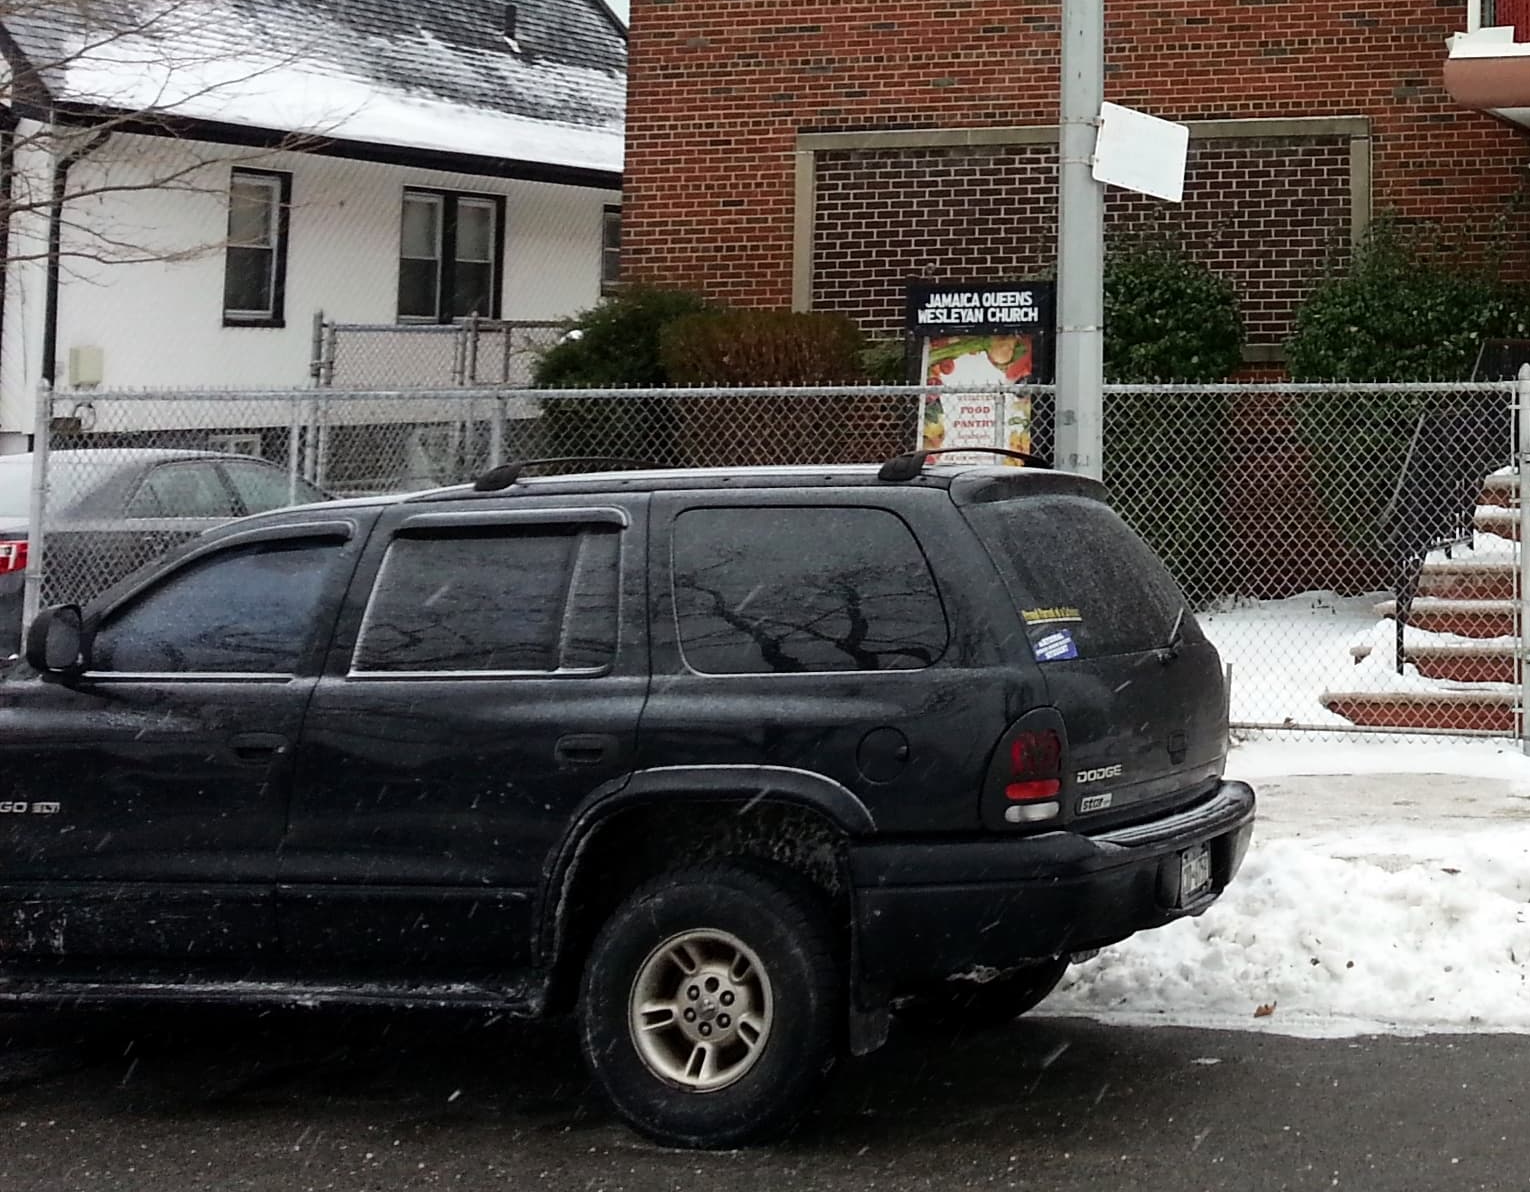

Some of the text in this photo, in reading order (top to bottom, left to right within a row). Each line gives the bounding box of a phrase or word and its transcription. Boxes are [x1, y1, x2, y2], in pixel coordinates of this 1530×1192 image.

[925, 291, 1033, 308] JAMAICA QUEENS
[917, 307, 1039, 324] WESLEYAN CHURCH
[960, 406, 991, 414] FOOD
[1076, 764, 1123, 783] DODGE
